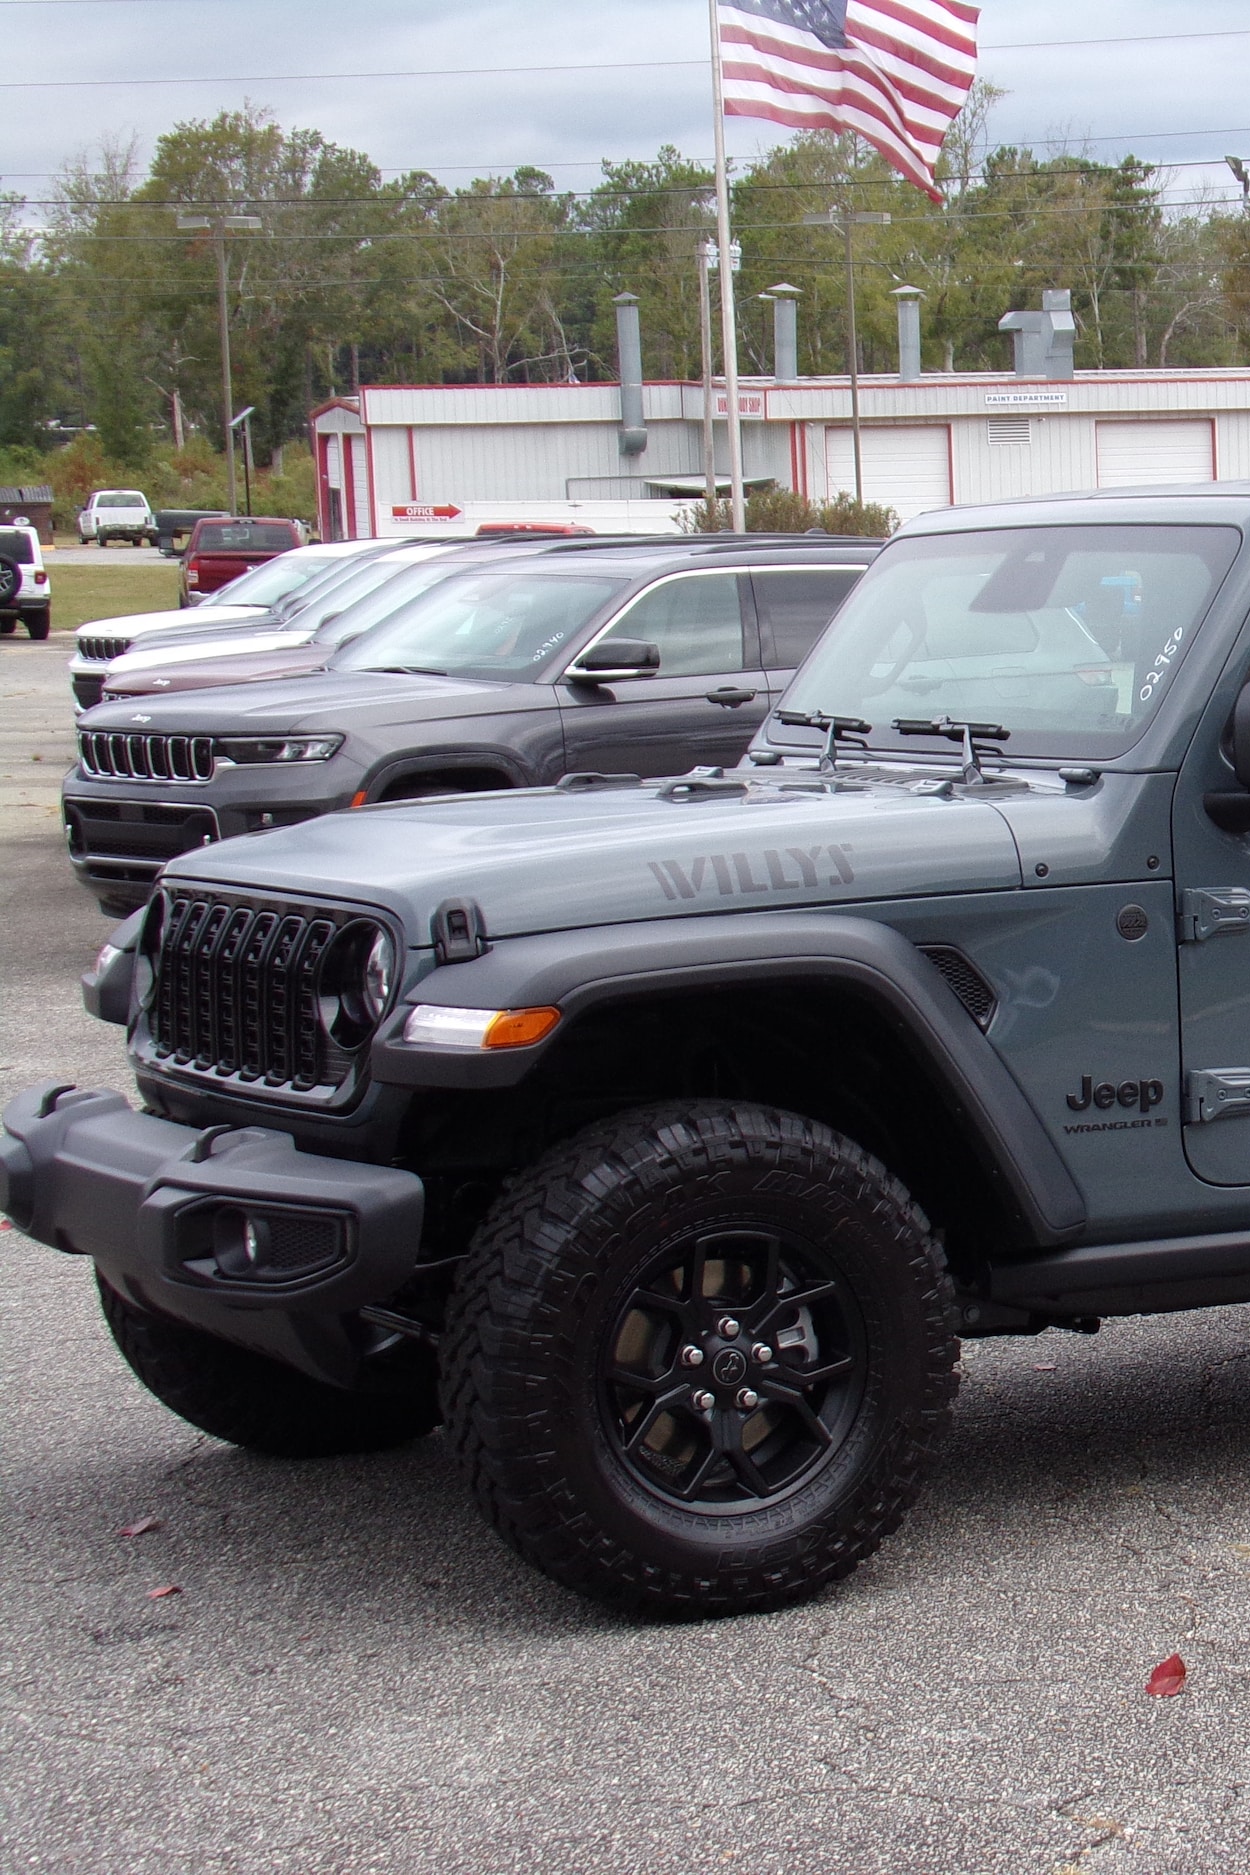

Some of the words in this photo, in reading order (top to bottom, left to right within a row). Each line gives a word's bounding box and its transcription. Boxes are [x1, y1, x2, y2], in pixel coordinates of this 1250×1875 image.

[406, 507, 434, 516] OFFICE
[1140, 626, 1183, 701] 02950
[648, 844, 855, 901] WILLYS
[1066, 1074, 1164, 1112] Jeep
[1063, 1119, 1152, 1135] WRANGLER
